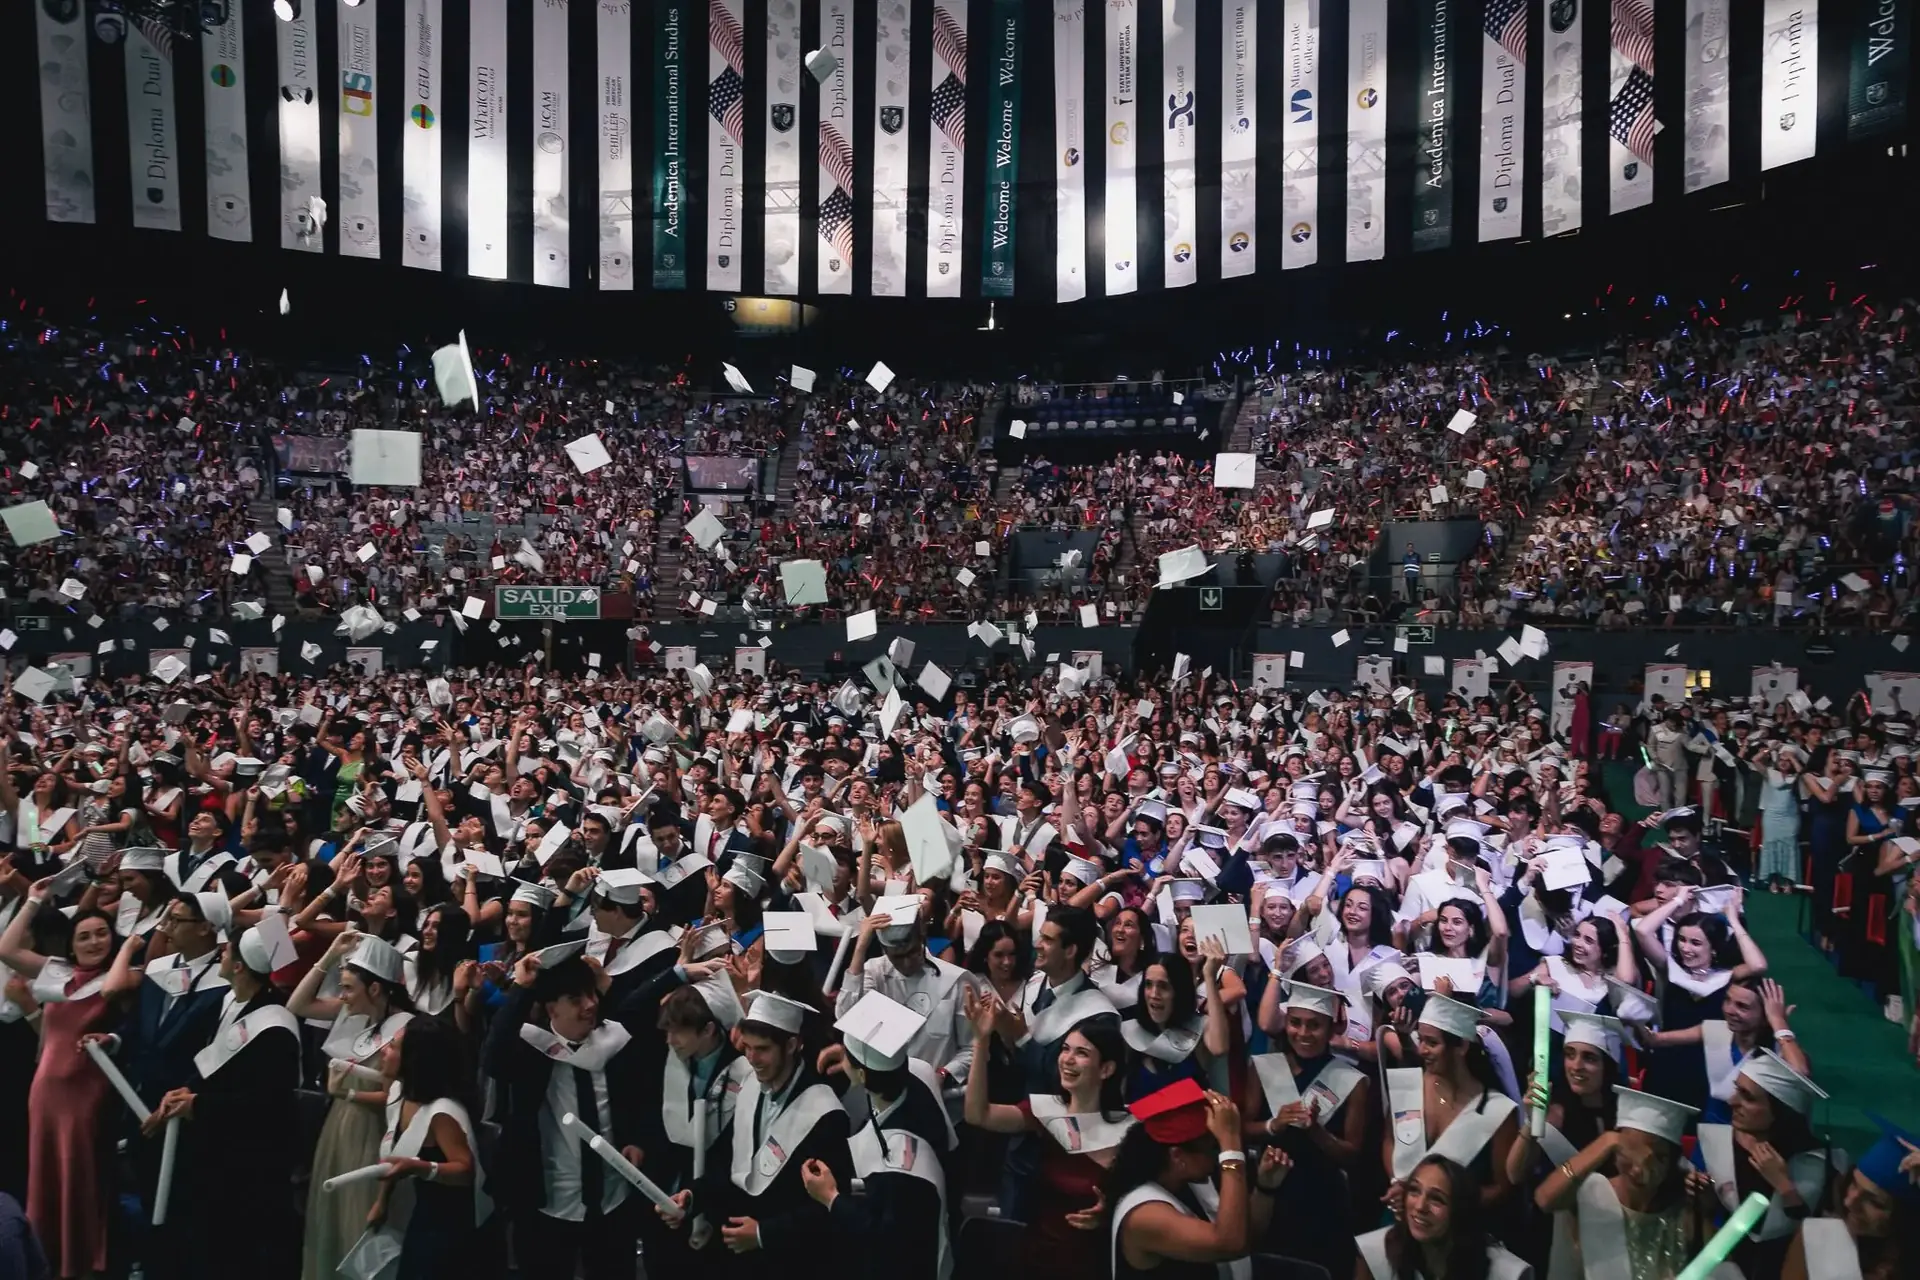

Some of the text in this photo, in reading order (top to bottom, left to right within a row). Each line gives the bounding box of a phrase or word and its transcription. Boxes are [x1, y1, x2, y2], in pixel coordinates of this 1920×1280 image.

[293, 19, 309, 79] NEBRIJA
[1236, 6, 1244, 38] FLORIDA
[1236, 40, 1244, 60] WEST
[1868, 0, 1896, 66] Welc
[417, 66, 431, 100] CEU
[1125, 55, 1131, 66] OF
[1290, 22, 1300, 88] Miami Dade
[1304, 32, 1314, 74] College
[1781, 9, 1806, 102] Diploma
[342, 70, 373, 117] CIS
[474, 66, 488, 139] Whatcom
[542, 92, 552, 129] UCAM
[830, 57, 848, 118] Diploma
[1176, 66, 1185, 104] COLLEGE
[1236, 73, 1244, 116] UNIVERSITY
[1426, 0, 1446, 188] Academica Internation
[145, 108, 170, 179] Diploma
[610, 112, 619, 160] SCHILLER
[664, 8, 678, 237] Academica International Studies
[993, 18, 1016, 250] Welcome Welcome Welcome
[1495, 115, 1516, 189] Diploma
[720, 186, 735, 248] Diploma
[940, 194, 955, 254] Diploma
[530, 604, 568, 616] EXIT
